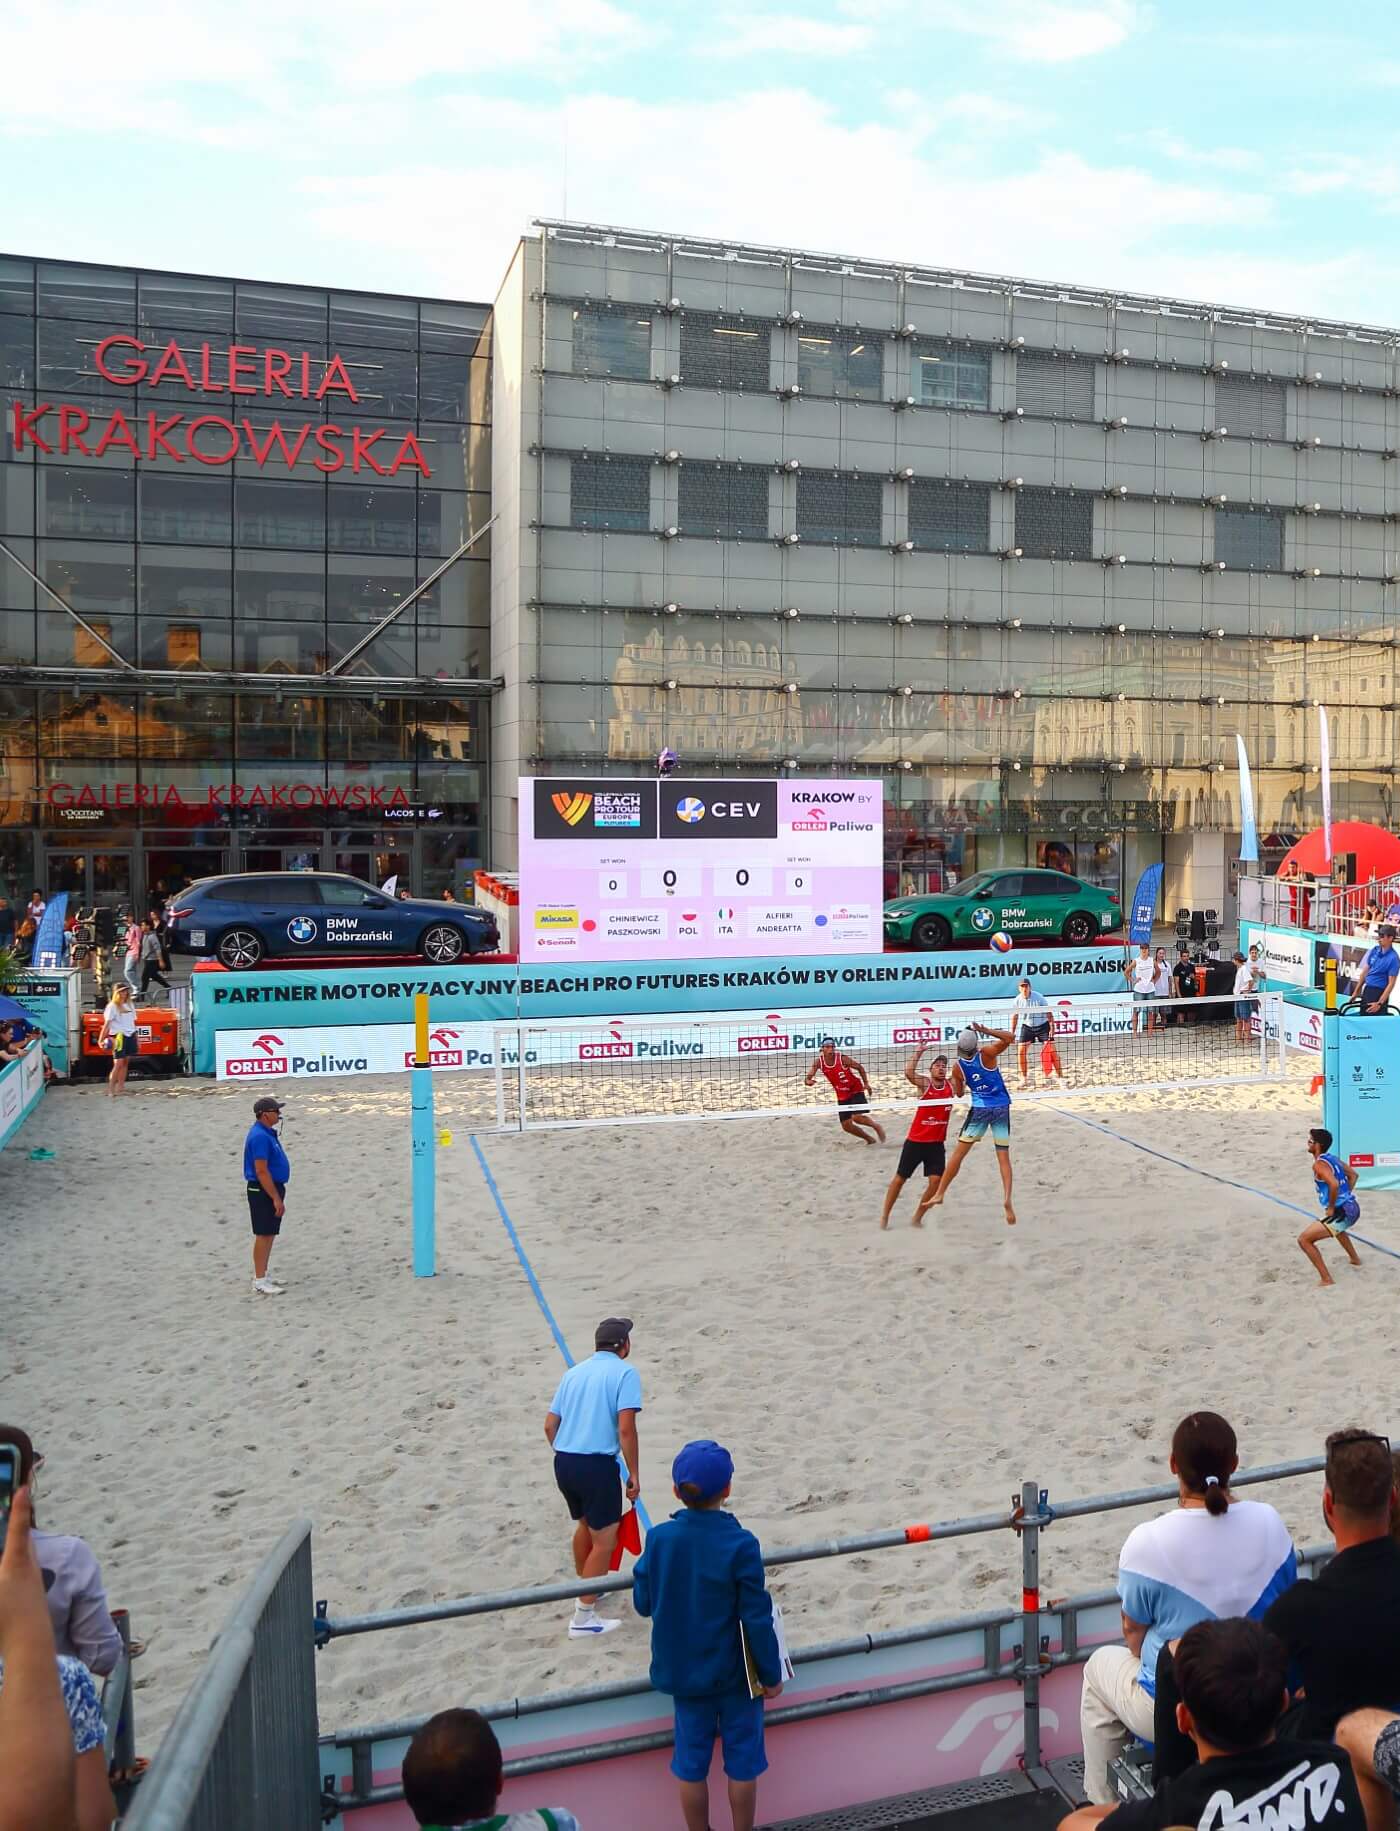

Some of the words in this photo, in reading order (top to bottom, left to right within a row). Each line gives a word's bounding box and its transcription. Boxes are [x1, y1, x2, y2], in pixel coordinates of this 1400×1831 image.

[95, 334, 361, 403] GALERIA
[12, 401, 432, 478] KRAKOWSKA
[48, 784, 183, 809] GALERIA
[208, 784, 410, 810] KRAKOWSKA
[594, 796, 641, 806] BEACH
[791, 793, 855, 803] KRAKOW
[385, 809, 425, 817] LACOSE
[711, 802, 761, 818] CEV
[793, 822, 826, 831] ORLEN
[829, 822, 873, 831] Paliwa
[663, 870, 677, 887] 0
[736, 869, 749, 886] 0
[794, 877, 803, 888] 0
[608, 880, 617, 891] 0
[1001, 908, 1026, 918] BMW
[326, 918, 358, 928] BMW
[609, 915, 659, 923] CHINIEWICZ
[1001, 918, 1053, 928] Dobrzański
[607, 928, 661, 936] PASZKOWSKI
[679, 927, 698, 935] POL
[718, 926, 733, 934] ITA
[756, 924, 802, 932] ANDREATTA
[326, 931, 393, 941] Dobrzański
[1266, 950, 1292, 964] Kruszywo
[1292, 954, 1304, 966] S.A.
[214, 986, 318, 1004] PARTNER
[321, 979, 517, 1001] MOTORYZACYJNY
[521, 978, 589, 994] BEACH
[593, 976, 632, 991] PRO
[637, 973, 720, 990] FUTURES
[723, 966, 811, 986] KRAKÓW
[814, 969, 840, 983] BY
[842, 967, 898, 982] ORLEN
[902, 965, 976, 980] PALIWA:
[979, 963, 1023, 978] BMW
[896, 1029, 938, 1042] ORLEN
[582, 1044, 631, 1058] ORLEN
[637, 1039, 704, 1057] Paliwa
[740, 1036, 787, 1051] ORLEN
[408, 1052, 458, 1066] OLEN
[466, 1047, 537, 1066] Paiwa
[229, 1060, 284, 1073] ORLEN
[292, 1053, 367, 1073] Paliwa
